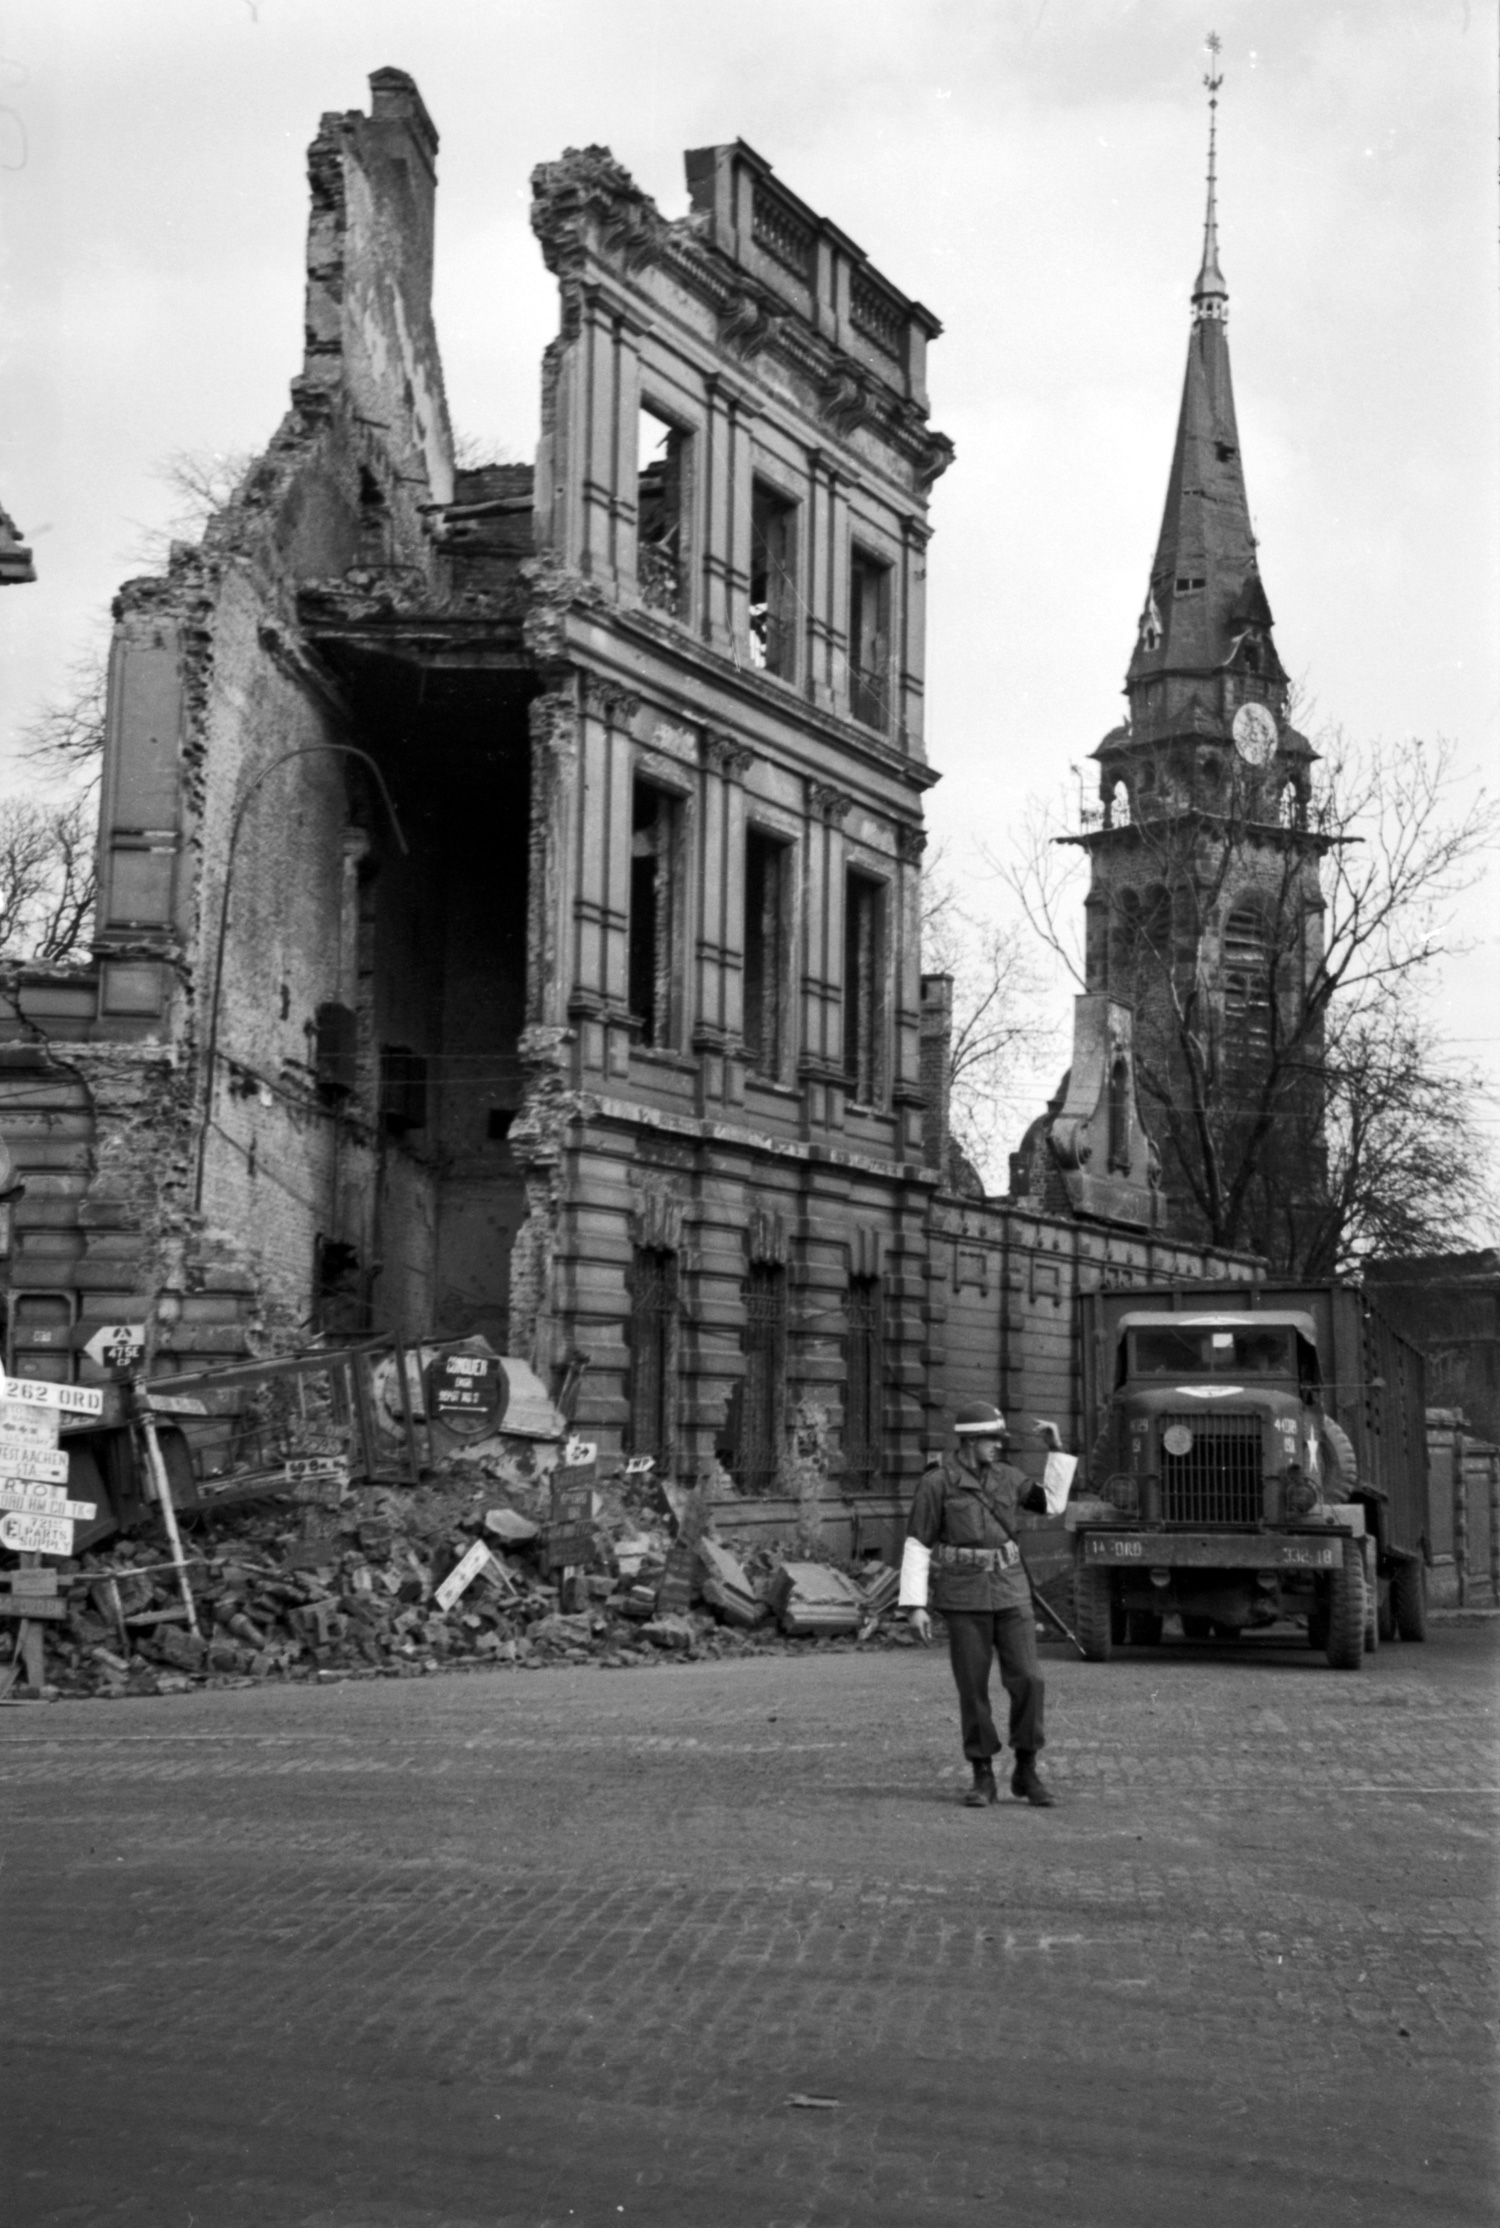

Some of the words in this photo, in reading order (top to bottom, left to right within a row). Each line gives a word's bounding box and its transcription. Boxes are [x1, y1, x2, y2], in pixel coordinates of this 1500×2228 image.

[446, 1356, 488, 1376] CONQUER
[6, 1382, 48, 1402] 262
[59, 1390, 101, 1410] ORD
[22, 1449, 66, 1466] AACHEN
[25, 1526, 68, 1541] PARTS
[19, 1536, 71, 1552] SUPPLY
